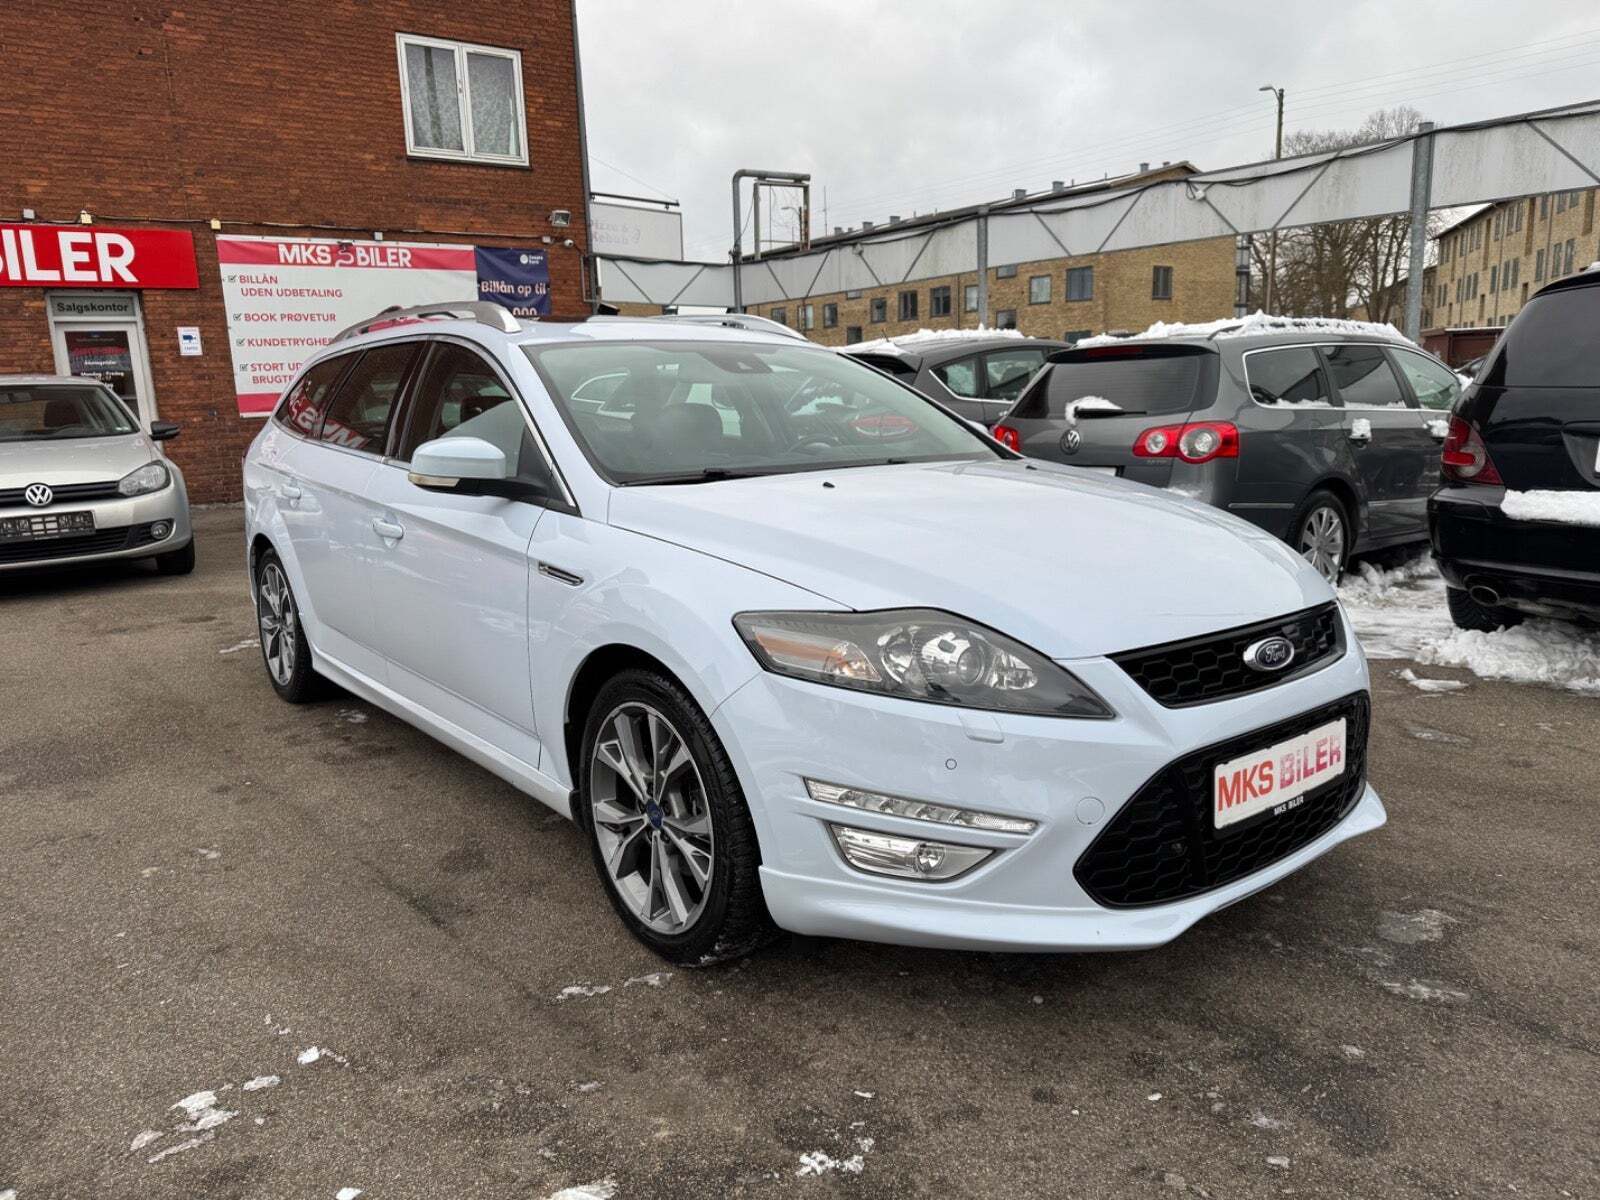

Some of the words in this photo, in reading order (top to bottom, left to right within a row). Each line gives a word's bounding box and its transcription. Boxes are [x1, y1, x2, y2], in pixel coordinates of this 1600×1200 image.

[0, 229, 139, 282] ILER
[278, 244, 332, 264] MKS
[356, 247, 412, 267] BILER
[241, 288, 273, 297] UDEN
[276, 288, 343, 298] UDBETALING
[481, 281, 515, 294] Billån
[517, 285, 532, 297] op
[535, 283, 546, 295] til
[57, 302, 129, 314] Salgskontor
[244, 313, 277, 322] BOOK
[280, 313, 336, 322] PRØVETUR
[250, 362, 284, 372] STORT
[1218, 760, 1274, 812] MKS
